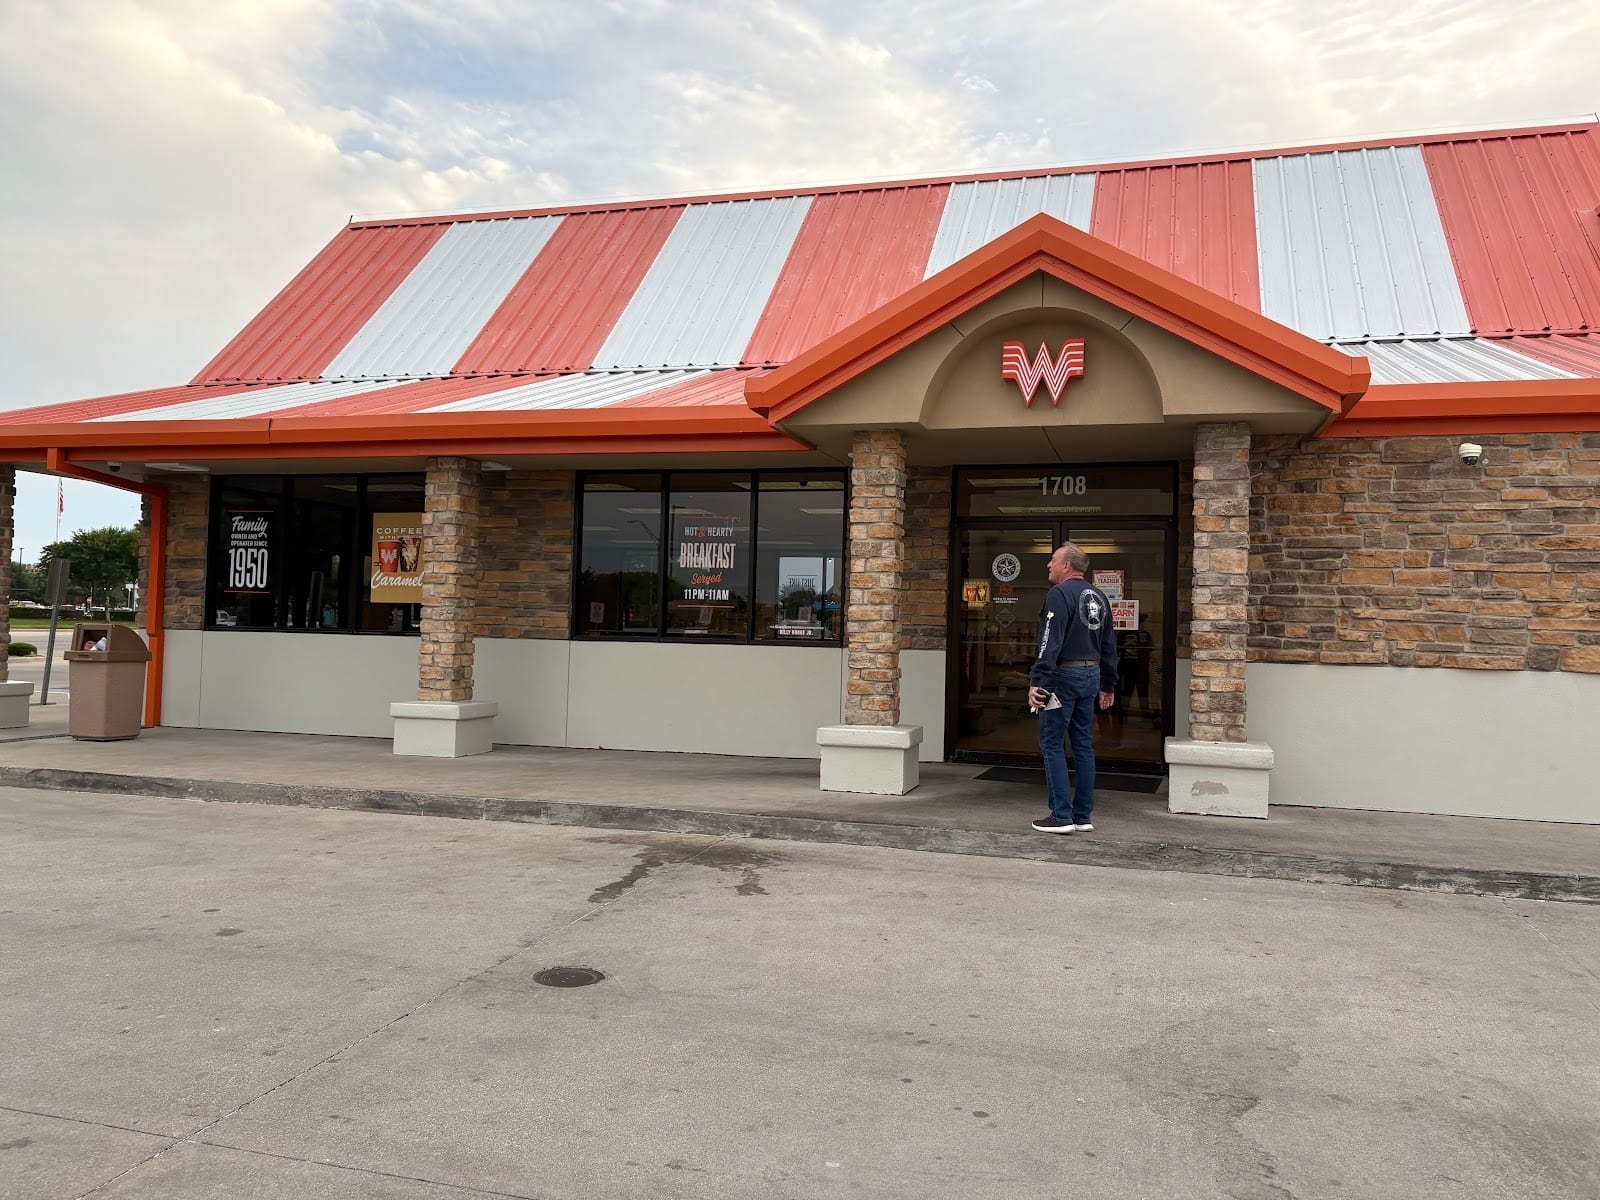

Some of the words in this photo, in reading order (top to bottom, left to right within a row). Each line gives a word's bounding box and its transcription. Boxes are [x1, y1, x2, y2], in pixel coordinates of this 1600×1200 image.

[1002, 337, 1085, 407] W
[1040, 476, 1087, 496] 1708
[232, 516, 268, 538] Family
[376, 527, 423, 535] COFFEE
[684, 526, 697, 537] HOT
[698, 526, 705, 538] &
[707, 527, 734, 537] HEARTY
[680, 543, 736, 569] BREAKFAST
[229, 548, 268, 588] 1950
[691, 571, 723, 584] Served
[371, 569, 424, 589] Caramel
